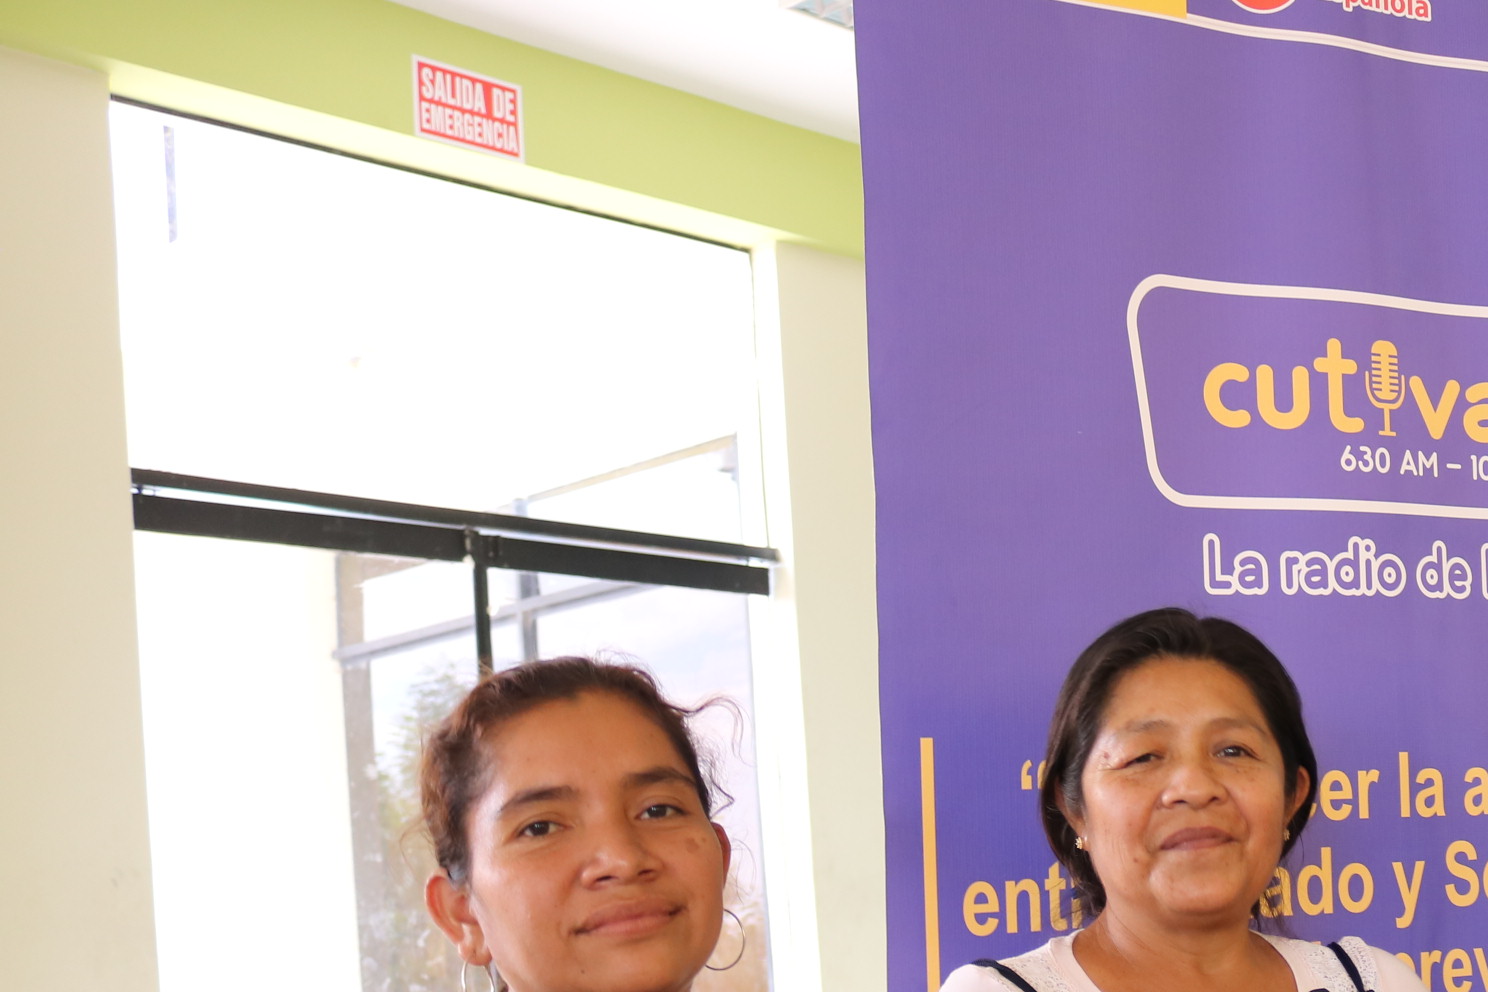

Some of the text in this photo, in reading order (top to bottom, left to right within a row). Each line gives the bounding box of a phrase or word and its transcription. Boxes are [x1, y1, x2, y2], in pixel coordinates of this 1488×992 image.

[421, 67, 516, 122] SALIDA DE
[421, 100, 518, 152] EMERGENCIA
[1341, 445, 1390, 474] 630
[1400, 450, 1438, 477] AM
[1203, 533, 1268, 595] La
[1280, 536, 1406, 597] radio
[1417, 540, 1472, 599] de
[1399, 751, 1445, 818] la
[1392, 859, 1424, 928] y
